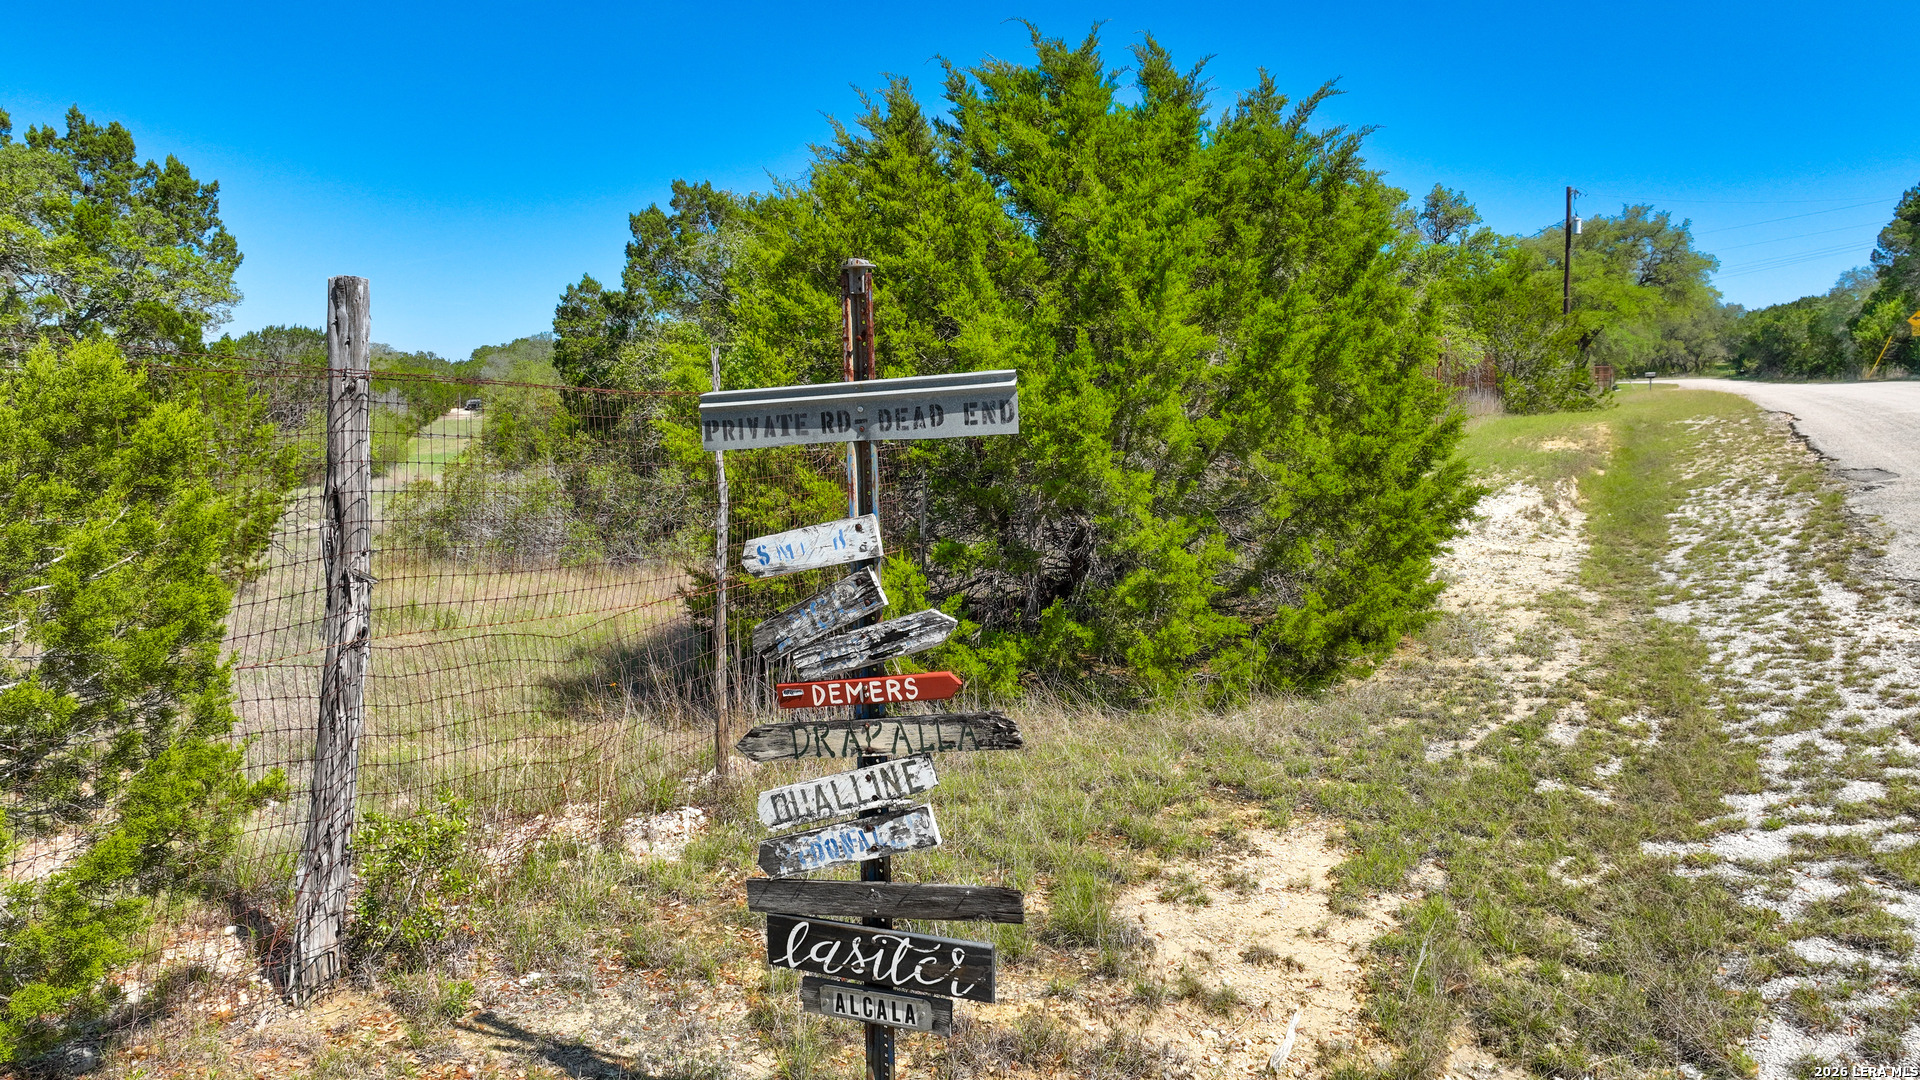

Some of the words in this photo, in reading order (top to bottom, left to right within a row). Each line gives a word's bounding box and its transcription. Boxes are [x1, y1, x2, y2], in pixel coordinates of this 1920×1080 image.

[703, 413, 808, 442] PRIVATE
[878, 404, 944, 432] DEAD
[963, 399, 1015, 425] END
[812, 677, 919, 706] DEMERS
[790, 718, 980, 760] DRAPALLA
[834, 992, 916, 1025] ALCALA
